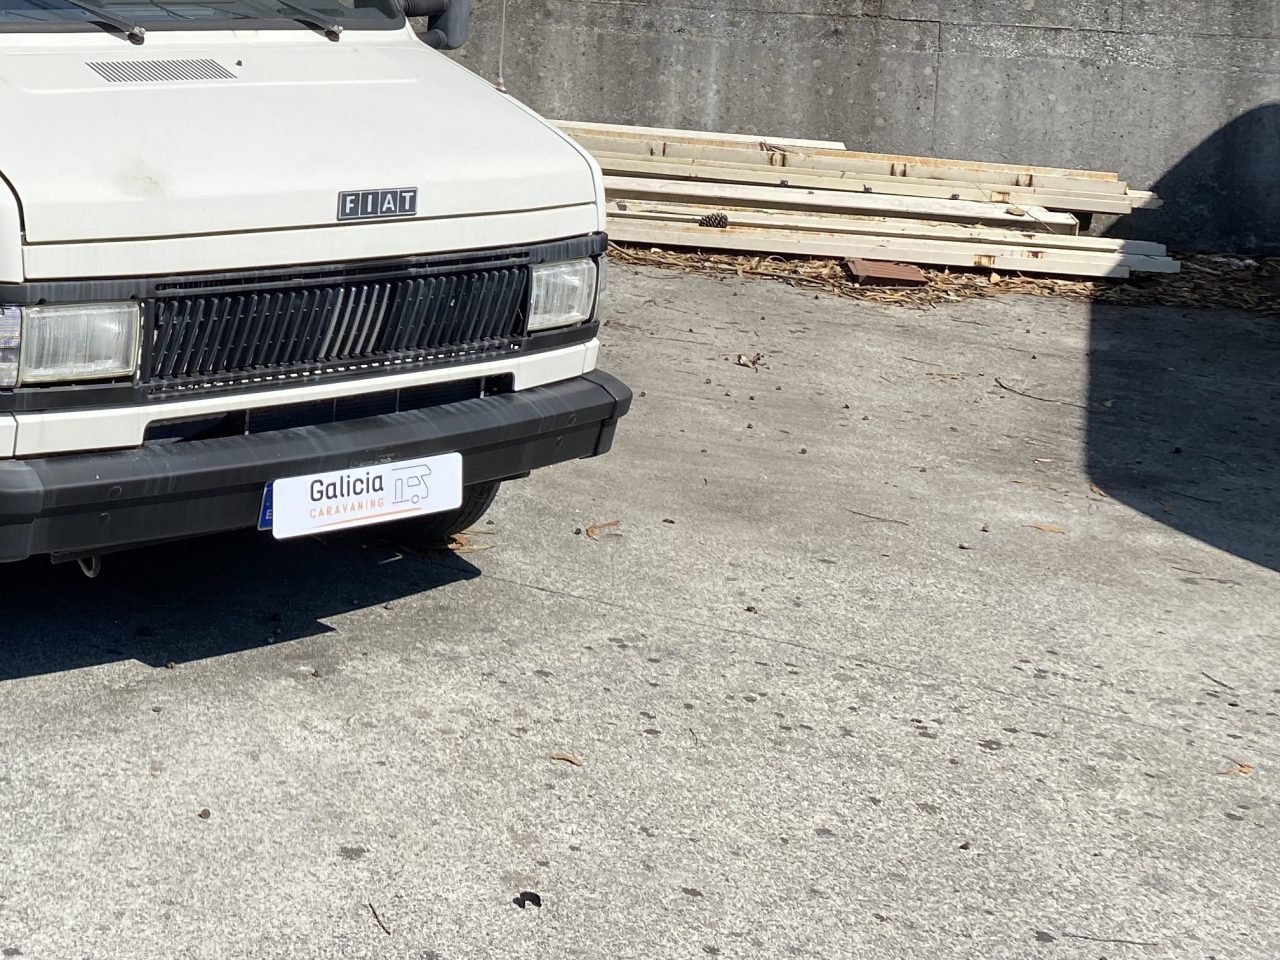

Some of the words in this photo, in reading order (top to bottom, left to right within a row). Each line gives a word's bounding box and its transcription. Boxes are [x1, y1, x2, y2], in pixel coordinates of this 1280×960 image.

[345, 192, 415, 213] FIAT
[309, 472, 384, 502] Galicia
[309, 497, 385, 519] CARAVANING
